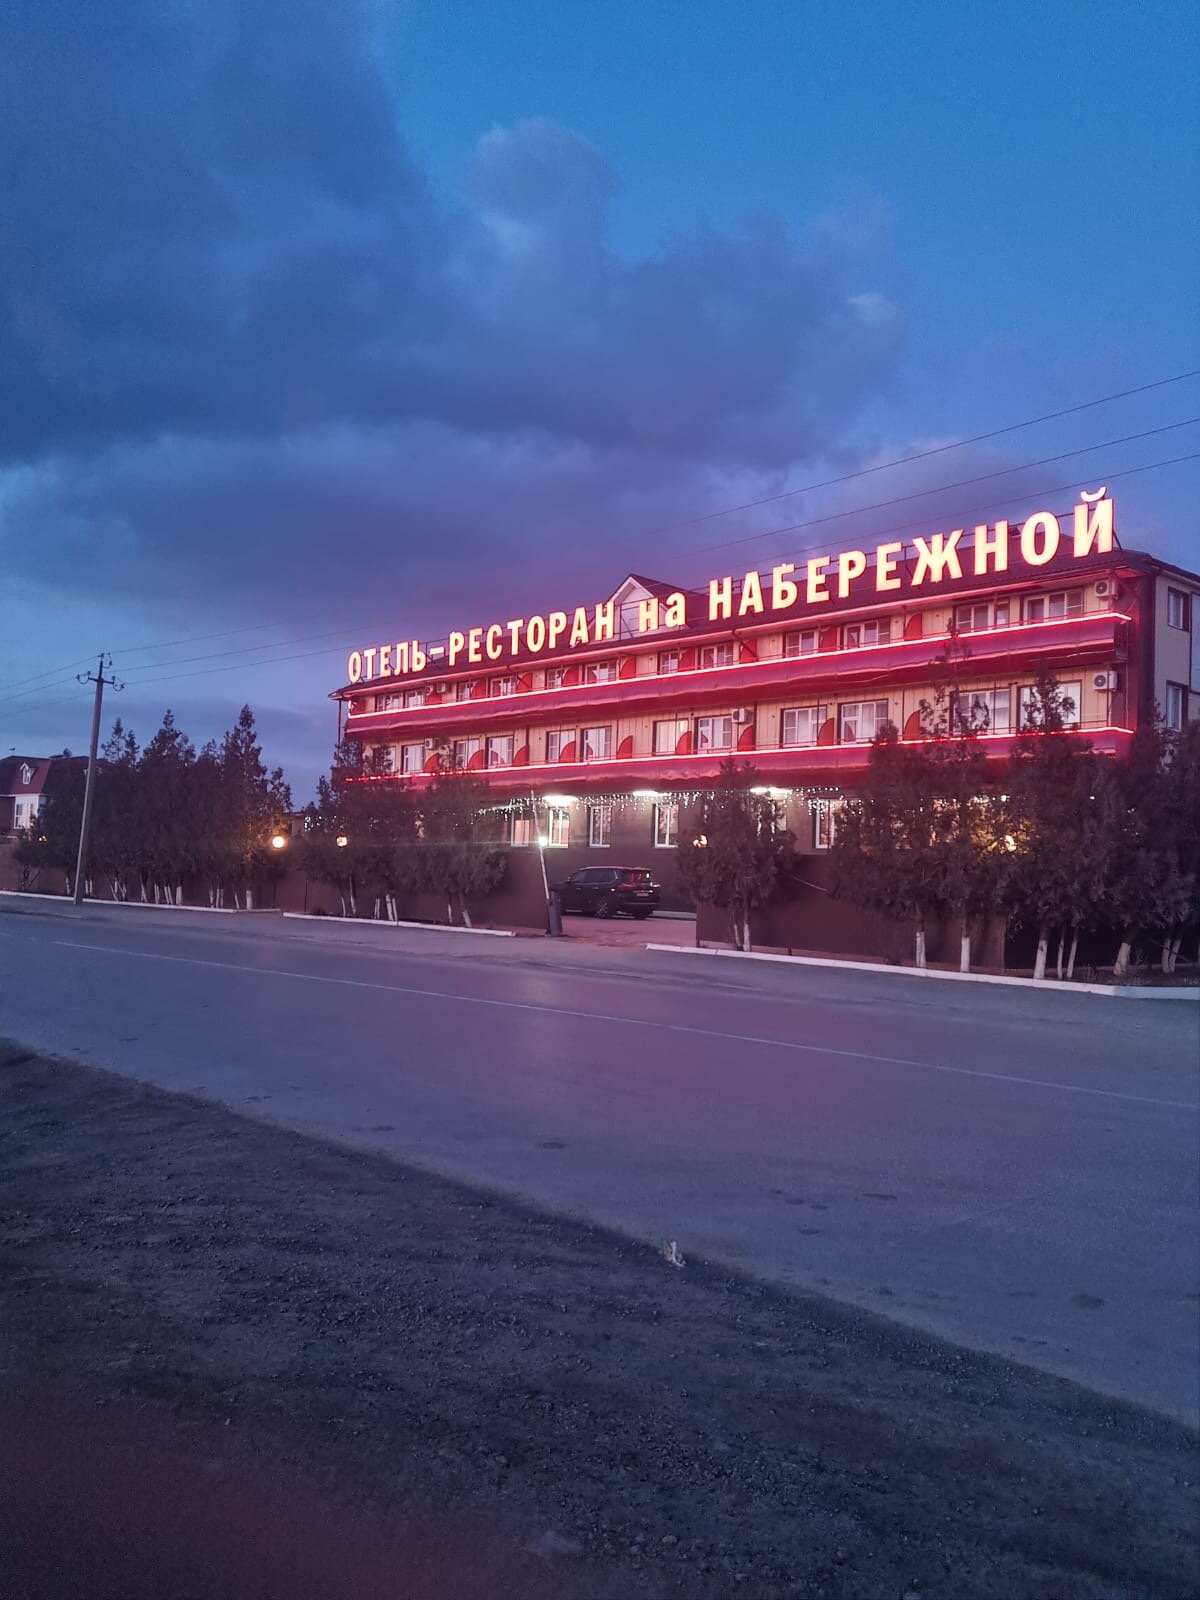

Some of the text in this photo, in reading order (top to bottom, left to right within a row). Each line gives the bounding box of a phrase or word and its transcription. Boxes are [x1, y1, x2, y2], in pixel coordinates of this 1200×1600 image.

[348, 486, 1114, 682] ОТЕЛЬ-РЕСТОРАН на НАБЕРЕЖНОЙ
